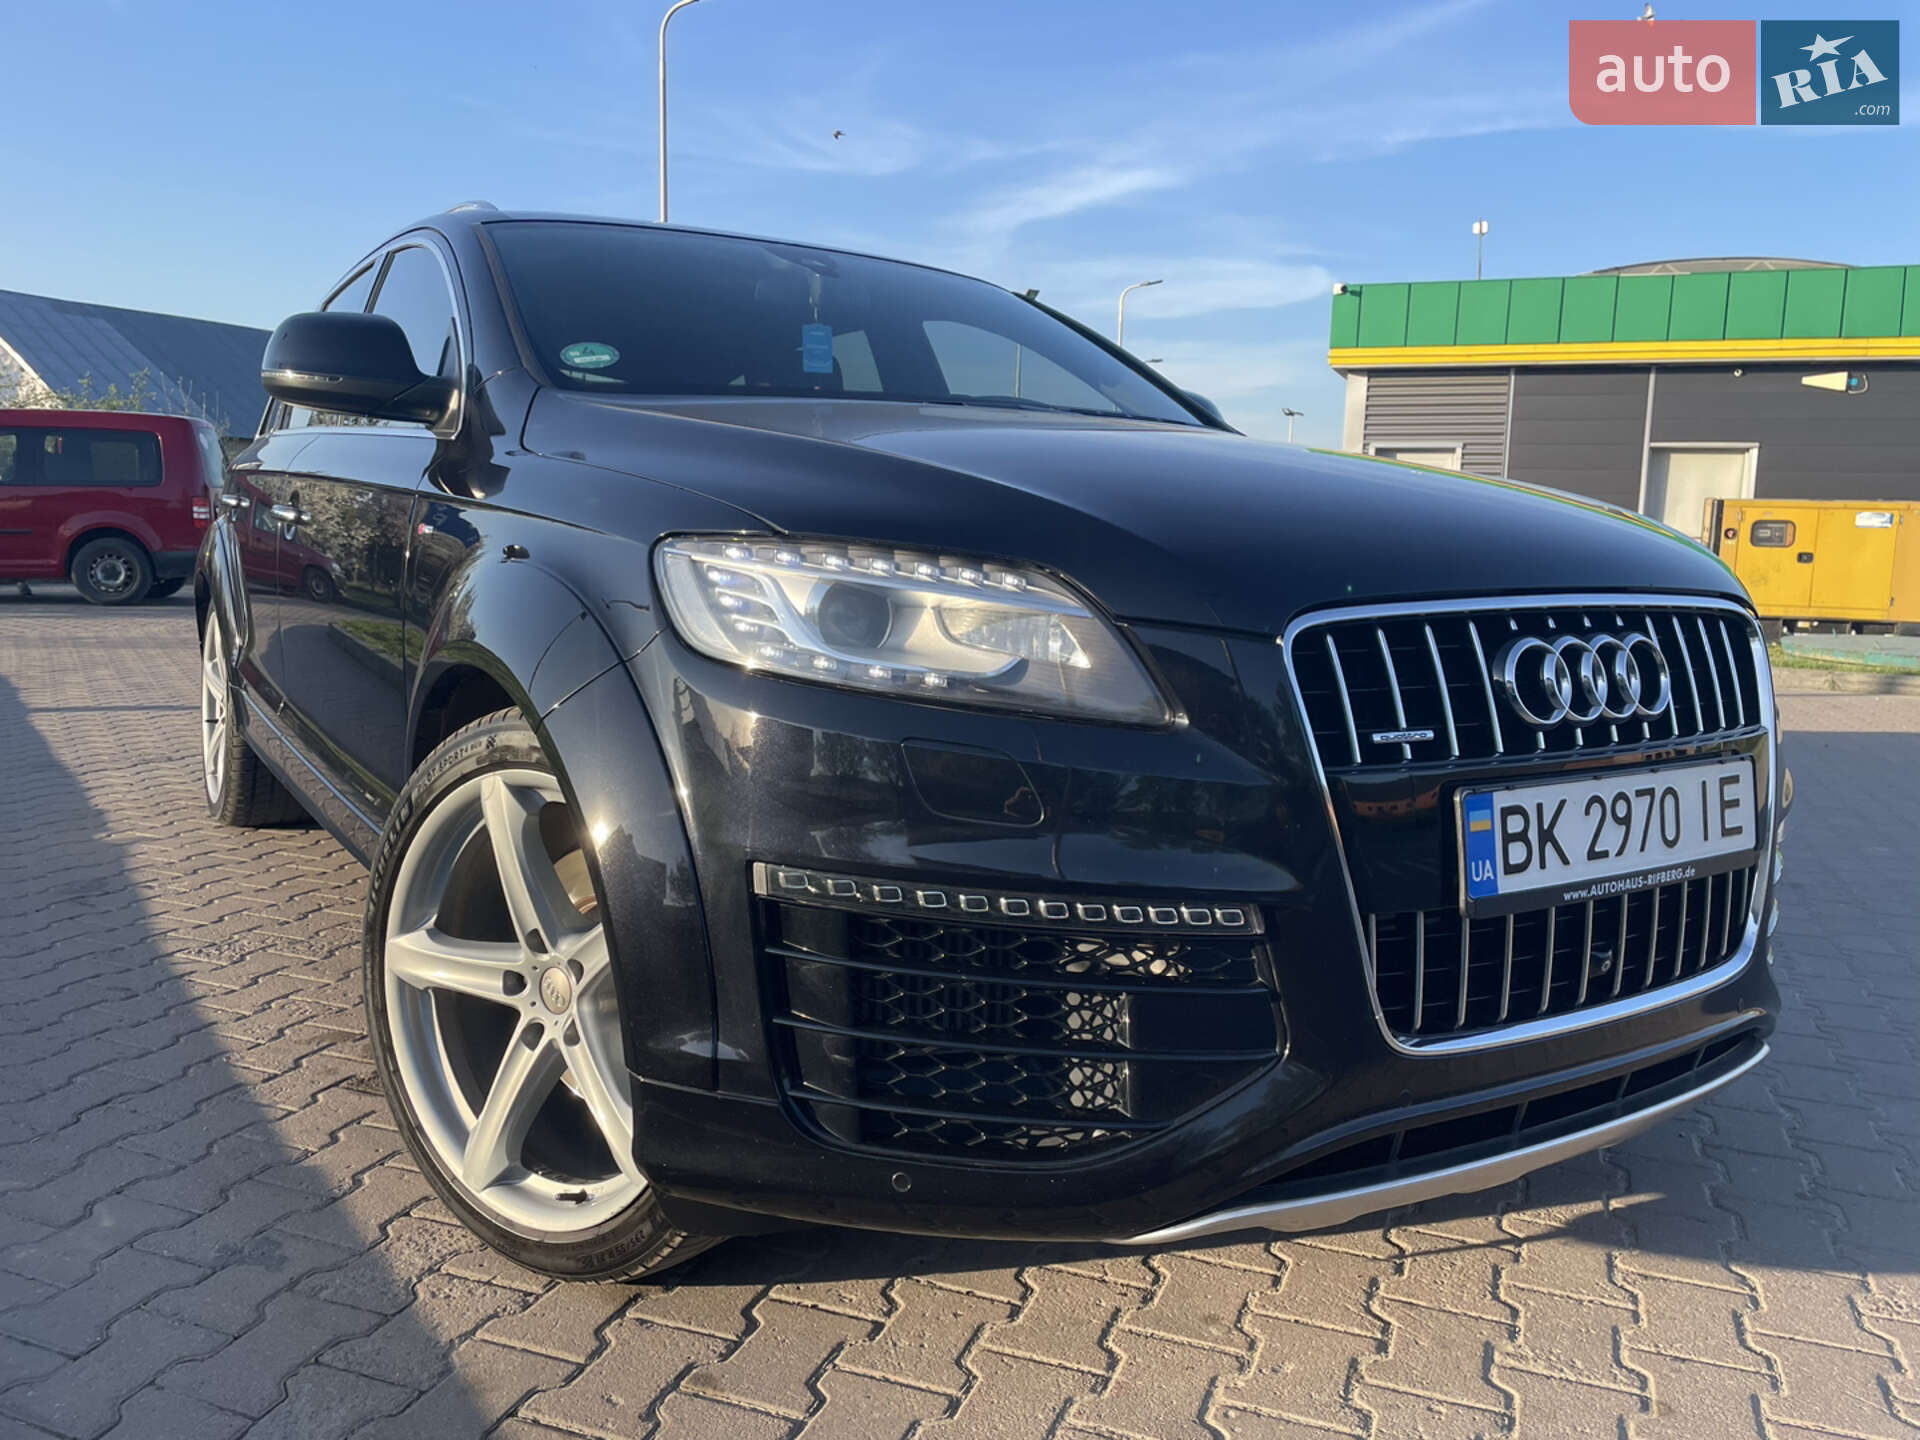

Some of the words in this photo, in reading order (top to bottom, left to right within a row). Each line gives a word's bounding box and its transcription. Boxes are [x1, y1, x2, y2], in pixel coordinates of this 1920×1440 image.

[1500, 799, 1570, 876] BK
[1584, 786, 1680, 861] 2970
[1701, 774, 1743, 842] IE
[1471, 858, 1494, 882] UA
